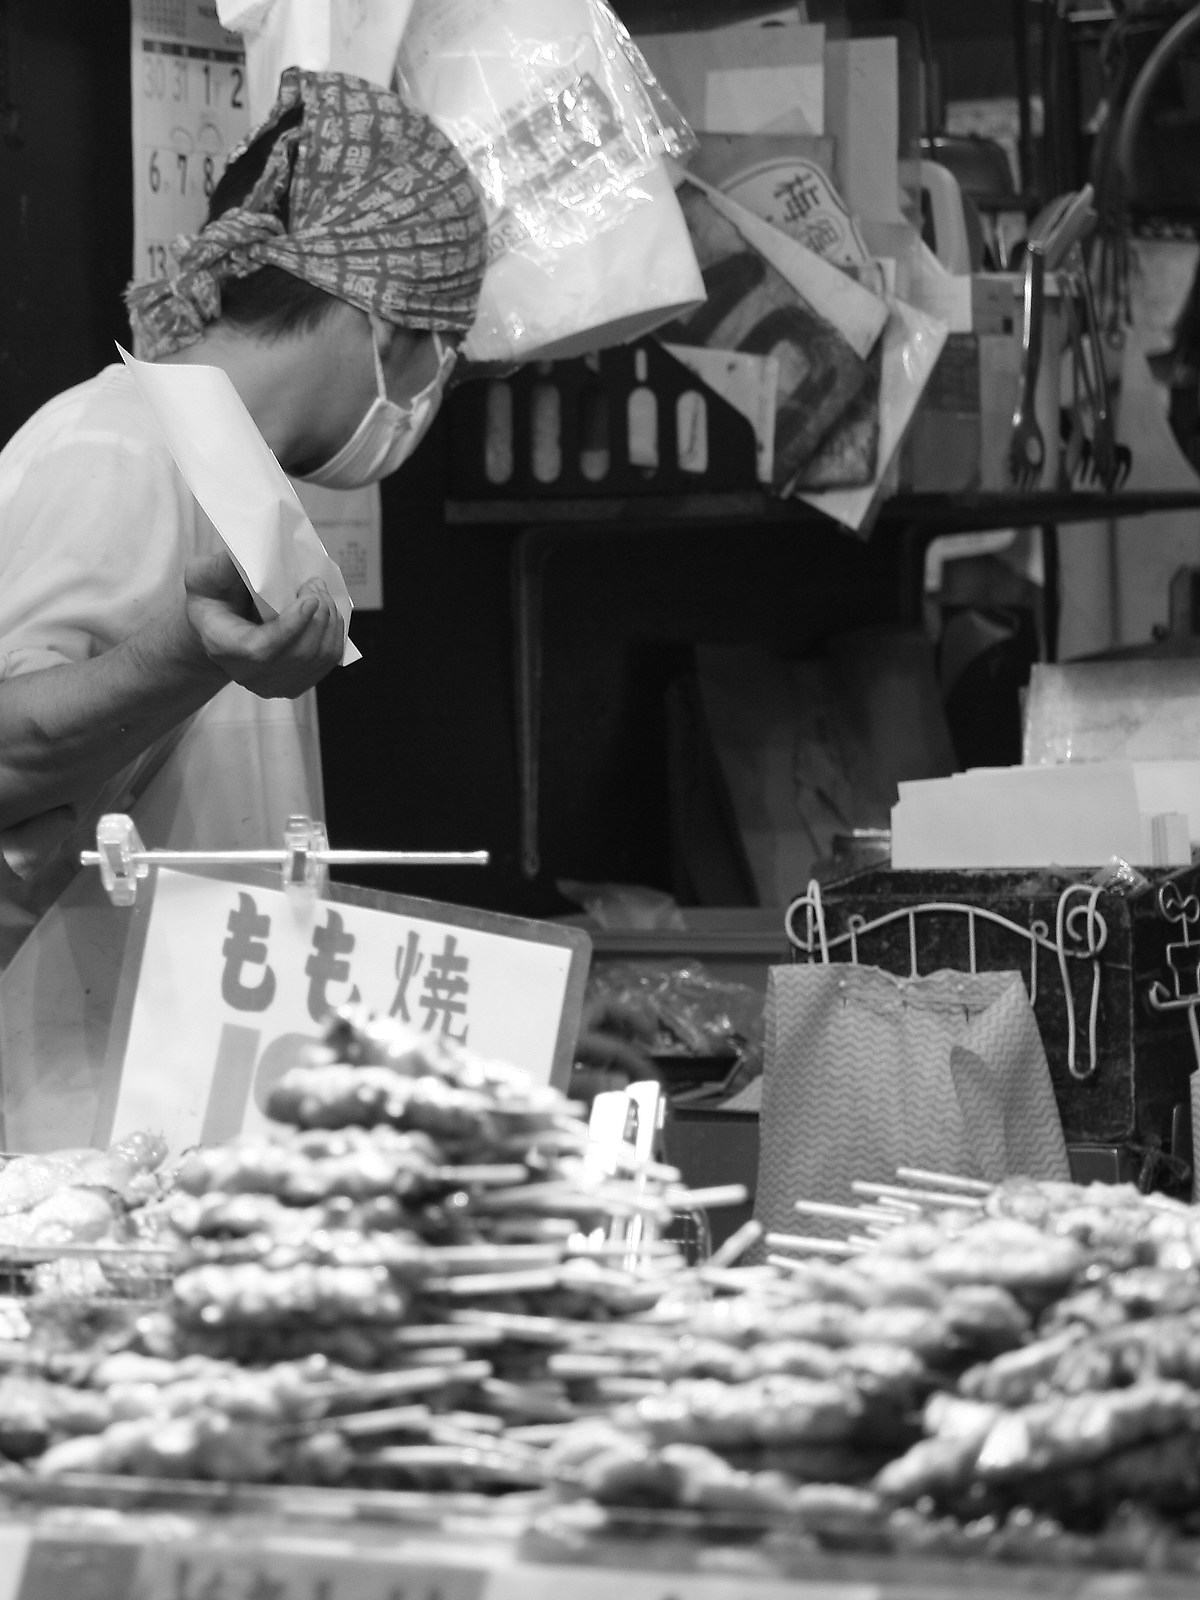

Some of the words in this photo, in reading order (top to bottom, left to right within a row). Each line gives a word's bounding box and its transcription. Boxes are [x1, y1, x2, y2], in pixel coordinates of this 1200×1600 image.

[231, 67, 243, 109] 2
[149, 151, 160, 193] 6
[177, 154, 187, 195] 7
[203, 157, 214, 197] 8
[221, 892, 469, 1047] もも焼
